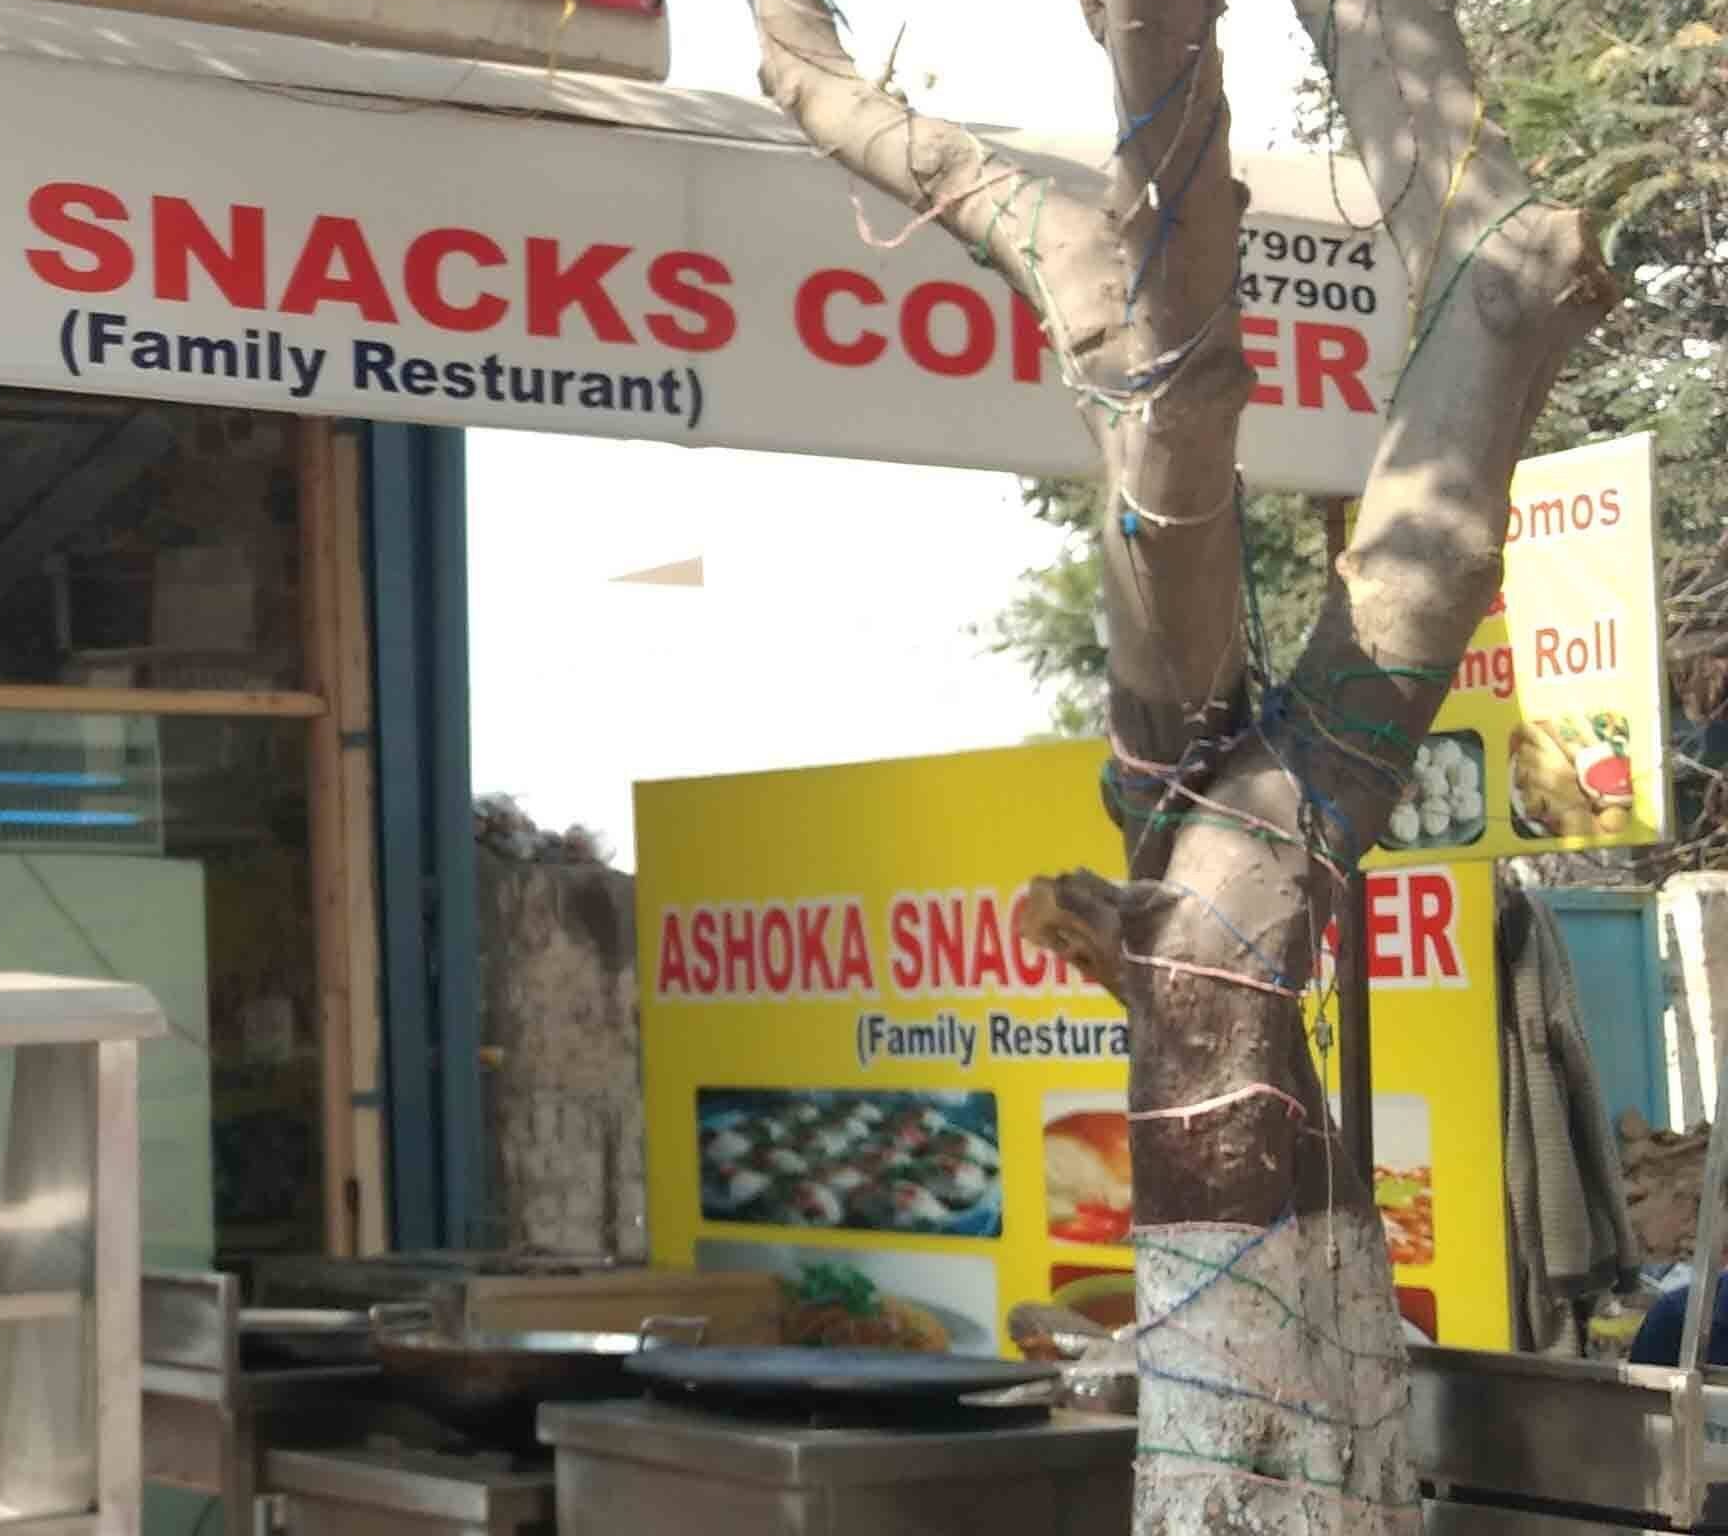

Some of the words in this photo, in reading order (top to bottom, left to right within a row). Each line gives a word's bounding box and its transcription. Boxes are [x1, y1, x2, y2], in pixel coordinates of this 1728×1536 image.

[23, 182, 737, 352] SNACKS
[793, 269, 1377, 413] COER
[57, 309, 322, 398] (Family
[350, 339, 704, 431] Resturant)
[1535, 619, 1617, 677] Roll
[658, 904, 873, 995] ASHOKA
[857, 1015, 977, 1065] (Family
